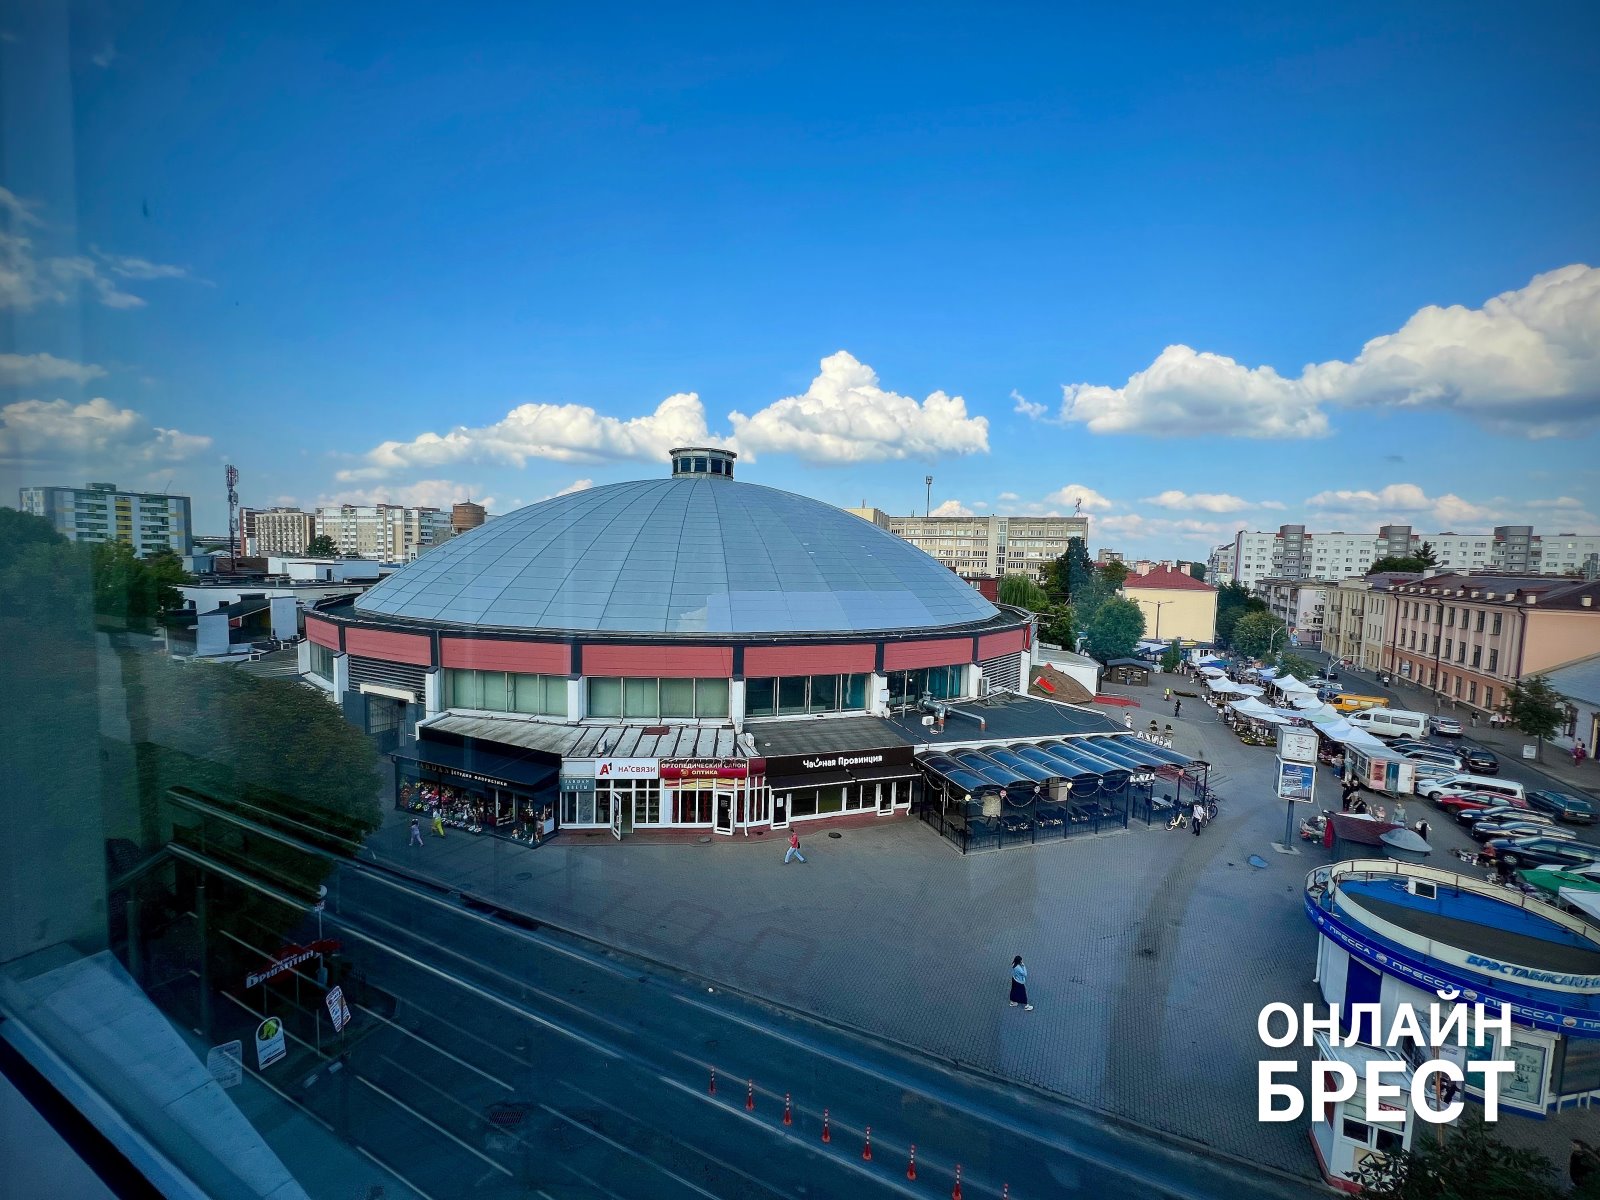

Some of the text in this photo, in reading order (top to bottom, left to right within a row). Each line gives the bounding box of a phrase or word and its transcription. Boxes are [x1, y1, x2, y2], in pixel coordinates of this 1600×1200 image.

[838, 754, 883, 767] Провинция
[600, 762, 613, 776] A1
[630, 765, 656, 773] СВЯЗИ
[1329, 925, 1371, 955] ПРЕССА
[1392, 961, 1455, 992] ПРЕССА
